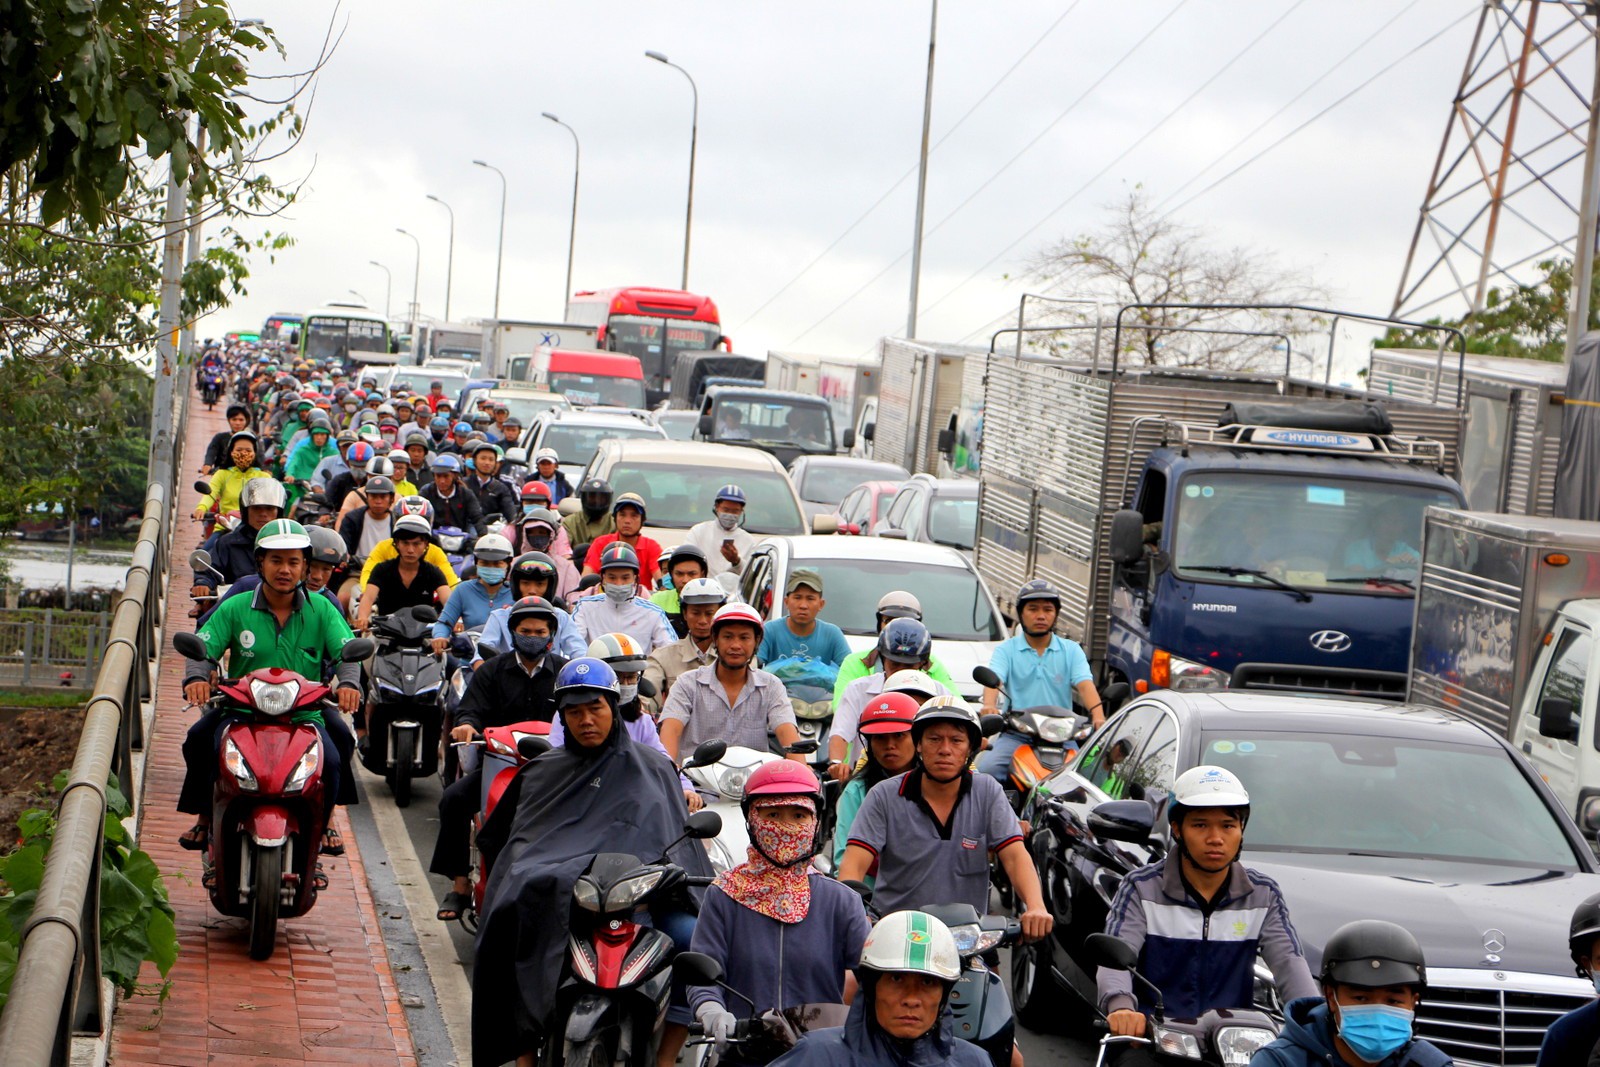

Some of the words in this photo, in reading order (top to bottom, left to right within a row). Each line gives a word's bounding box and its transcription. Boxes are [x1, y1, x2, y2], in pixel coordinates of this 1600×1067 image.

[1289, 432, 1338, 444] HYUNDAI
[1192, 603, 1237, 613] HYUNDAI
[240, 649, 255, 658] Grab
